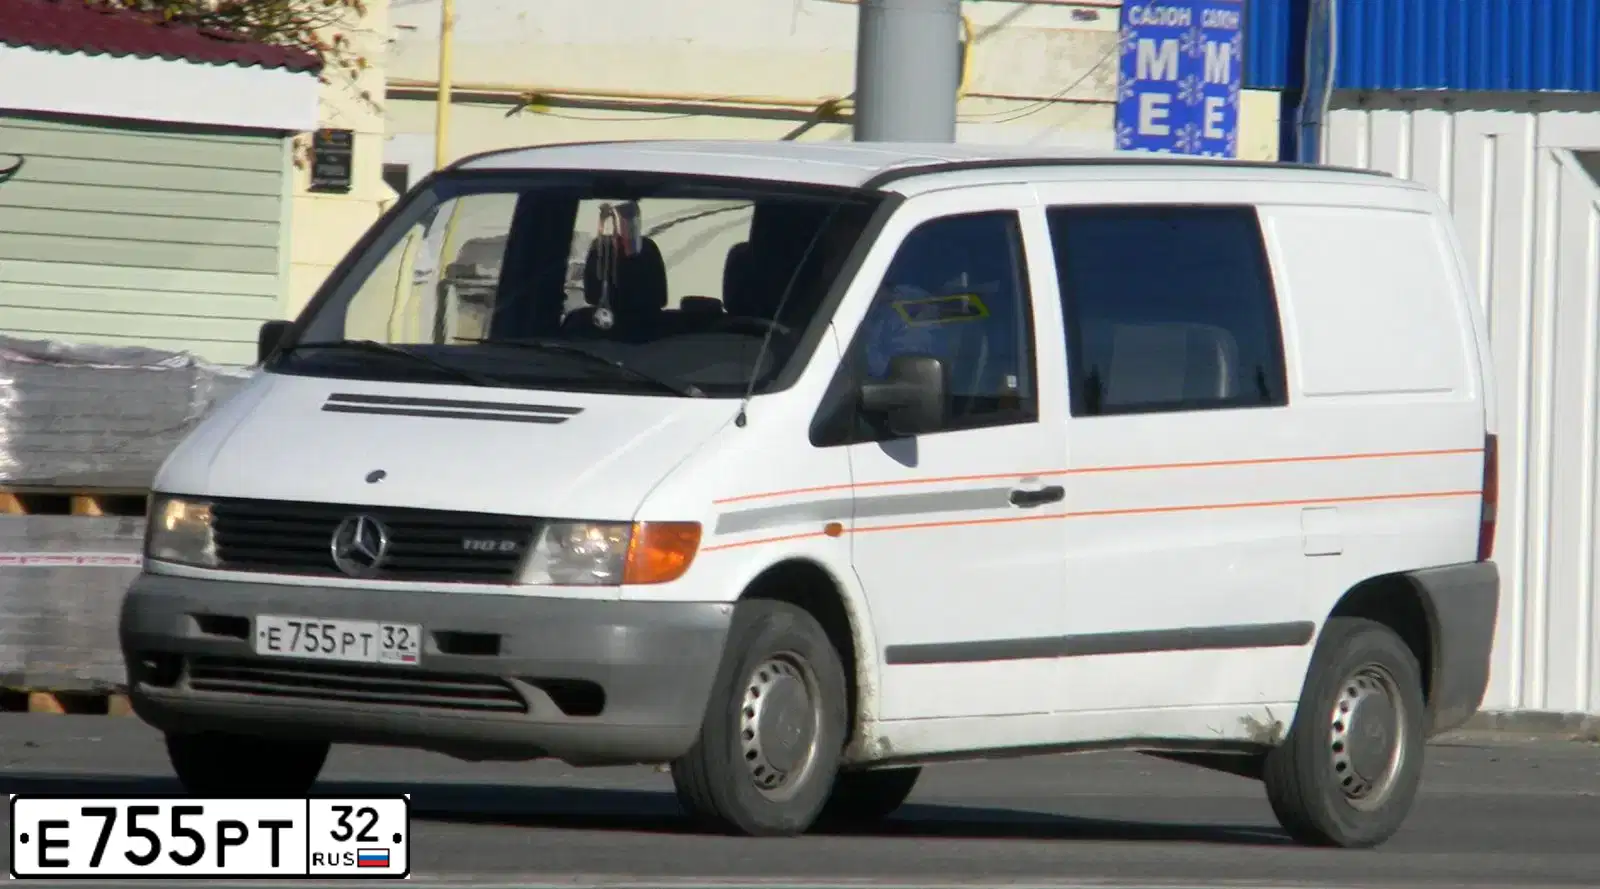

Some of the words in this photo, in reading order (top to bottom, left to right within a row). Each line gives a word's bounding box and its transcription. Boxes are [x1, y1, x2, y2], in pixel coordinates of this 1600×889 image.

[1128, 5, 1192, 26] САЛОН
[1136, 38, 1179, 155] МЕ
[1202, 41, 1231, 157] МЕ
[382, 626, 409, 650] 32
